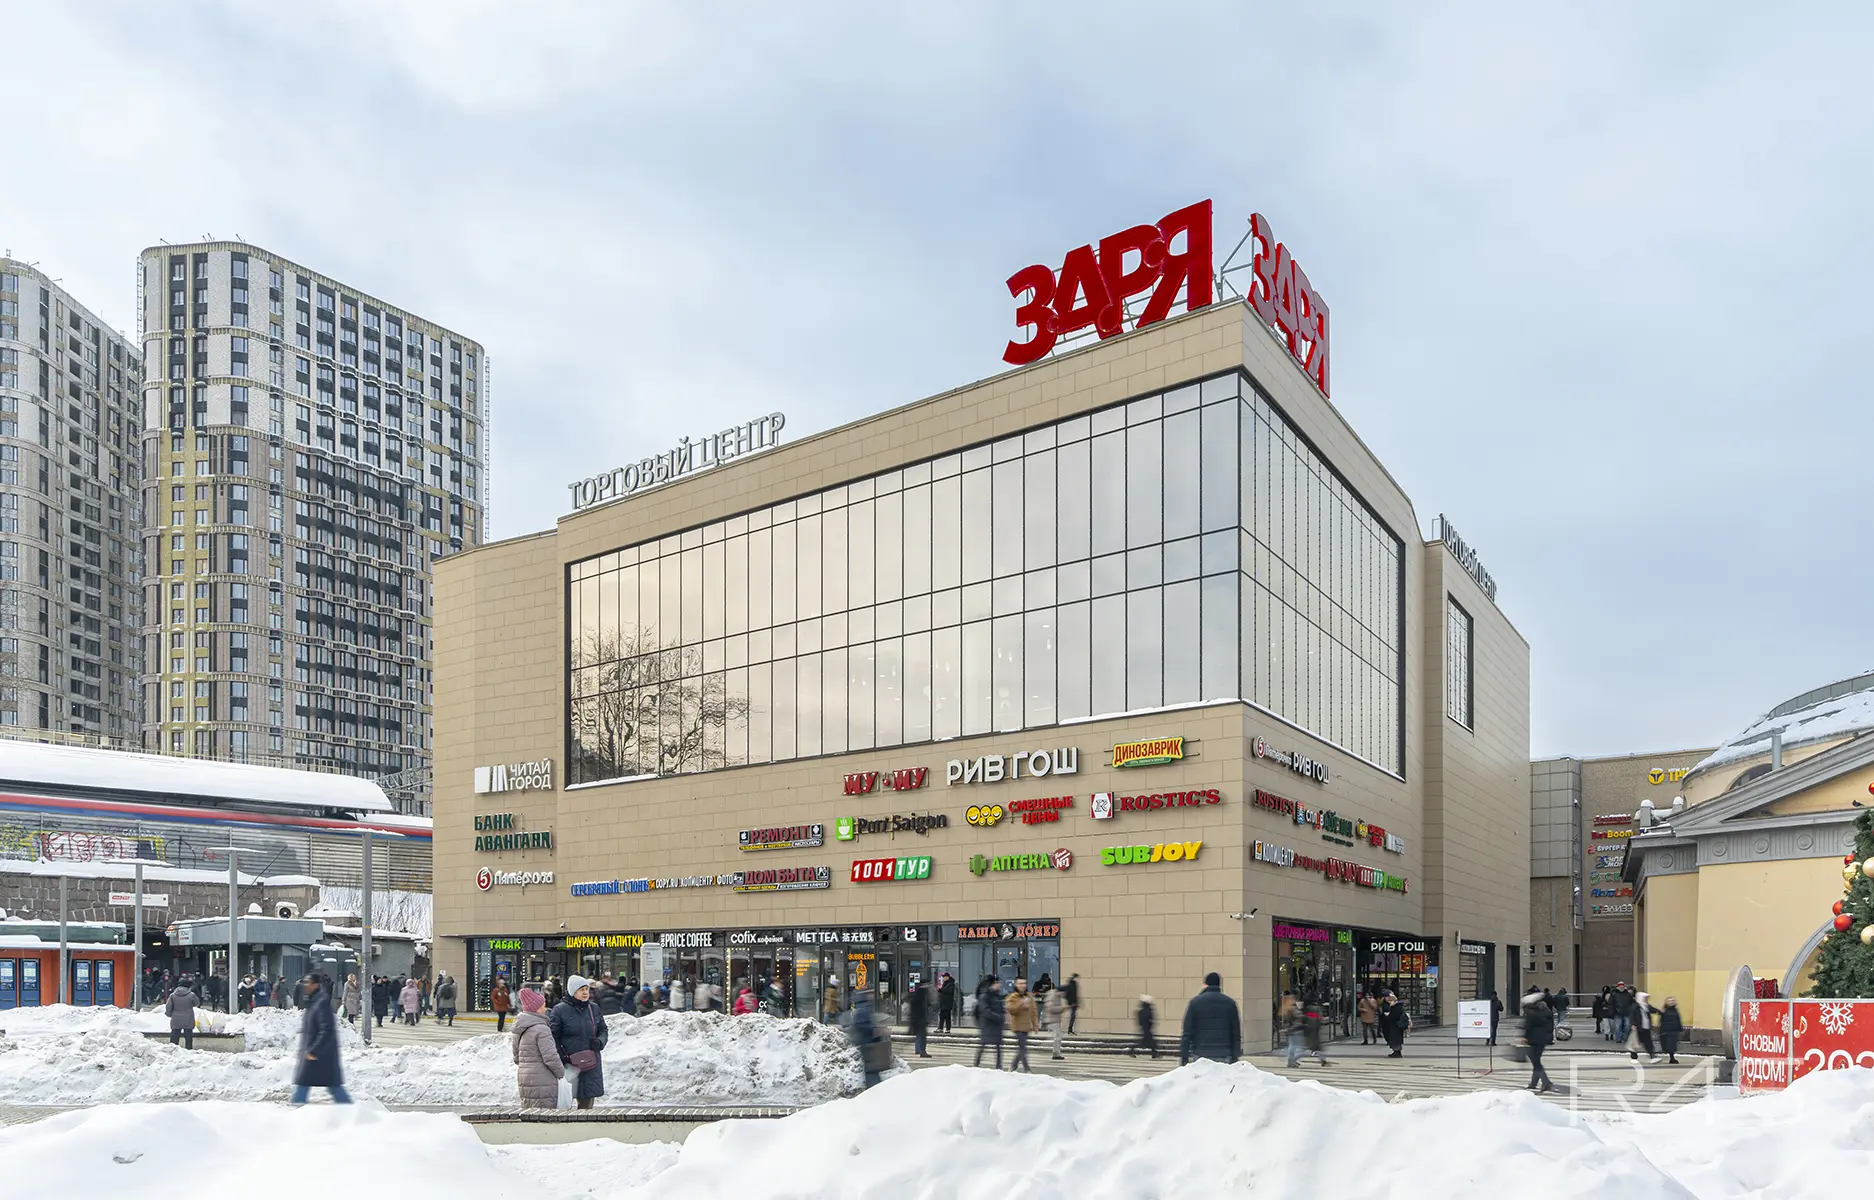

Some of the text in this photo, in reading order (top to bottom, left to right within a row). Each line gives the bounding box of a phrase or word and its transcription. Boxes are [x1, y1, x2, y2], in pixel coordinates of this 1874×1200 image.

[1003, 199, 1212, 365] ЗАРЯ
[1248, 213, 1330, 399] ЗАРЯ
[568, 412, 785, 509] ТОРГОВЫЙ ЦЕНТР
[1114, 739, 1181, 765] ДИНОЗАВРИК
[510, 758, 551, 776] ЧИТАЙ
[947, 747, 1078, 785] РИВ ГОШ
[1294, 752, 1311, 776] РИВ
[1313, 761, 1330, 784] ГОШ
[510, 775, 552, 790] ГОРОД
[1008, 796, 1073, 813] СМЕШНЫЕ
[1120, 789, 1220, 811] ROSTIC'S
[1257, 789, 1294, 815] ROSTIC'S
[474, 813, 513, 831] БАНК
[892, 812, 947, 834] Saigon
[1022, 810, 1059, 825] ЦЕНЫ
[475, 831, 552, 851] АВАНГАРД
[751, 825, 809, 844] РЕМОНТ
[991, 853, 1050, 871] АПТЕКА
[1101, 841, 1202, 865] SUBJOY
[745, 867, 816, 885] ДОМ БЫТА
[853, 859, 929, 879] 1001 ТУР
[666, 933, 685, 947] PRICE
[687, 932, 712, 947] COFFEE
[731, 931, 783, 945] cofix кофейня
[797, 932, 819, 943] MET
[820, 932, 838, 943] TEA
[905, 927, 917, 941] t2
[958, 927, 998, 938] ПАША
[489, 939, 521, 949] ТАБАК
[1371, 942, 1424, 951] РИВ ГОШ
[1750, 1034, 1785, 1054] НОВЫМ
[1742, 1057, 1785, 1083] ГОДОМ!
